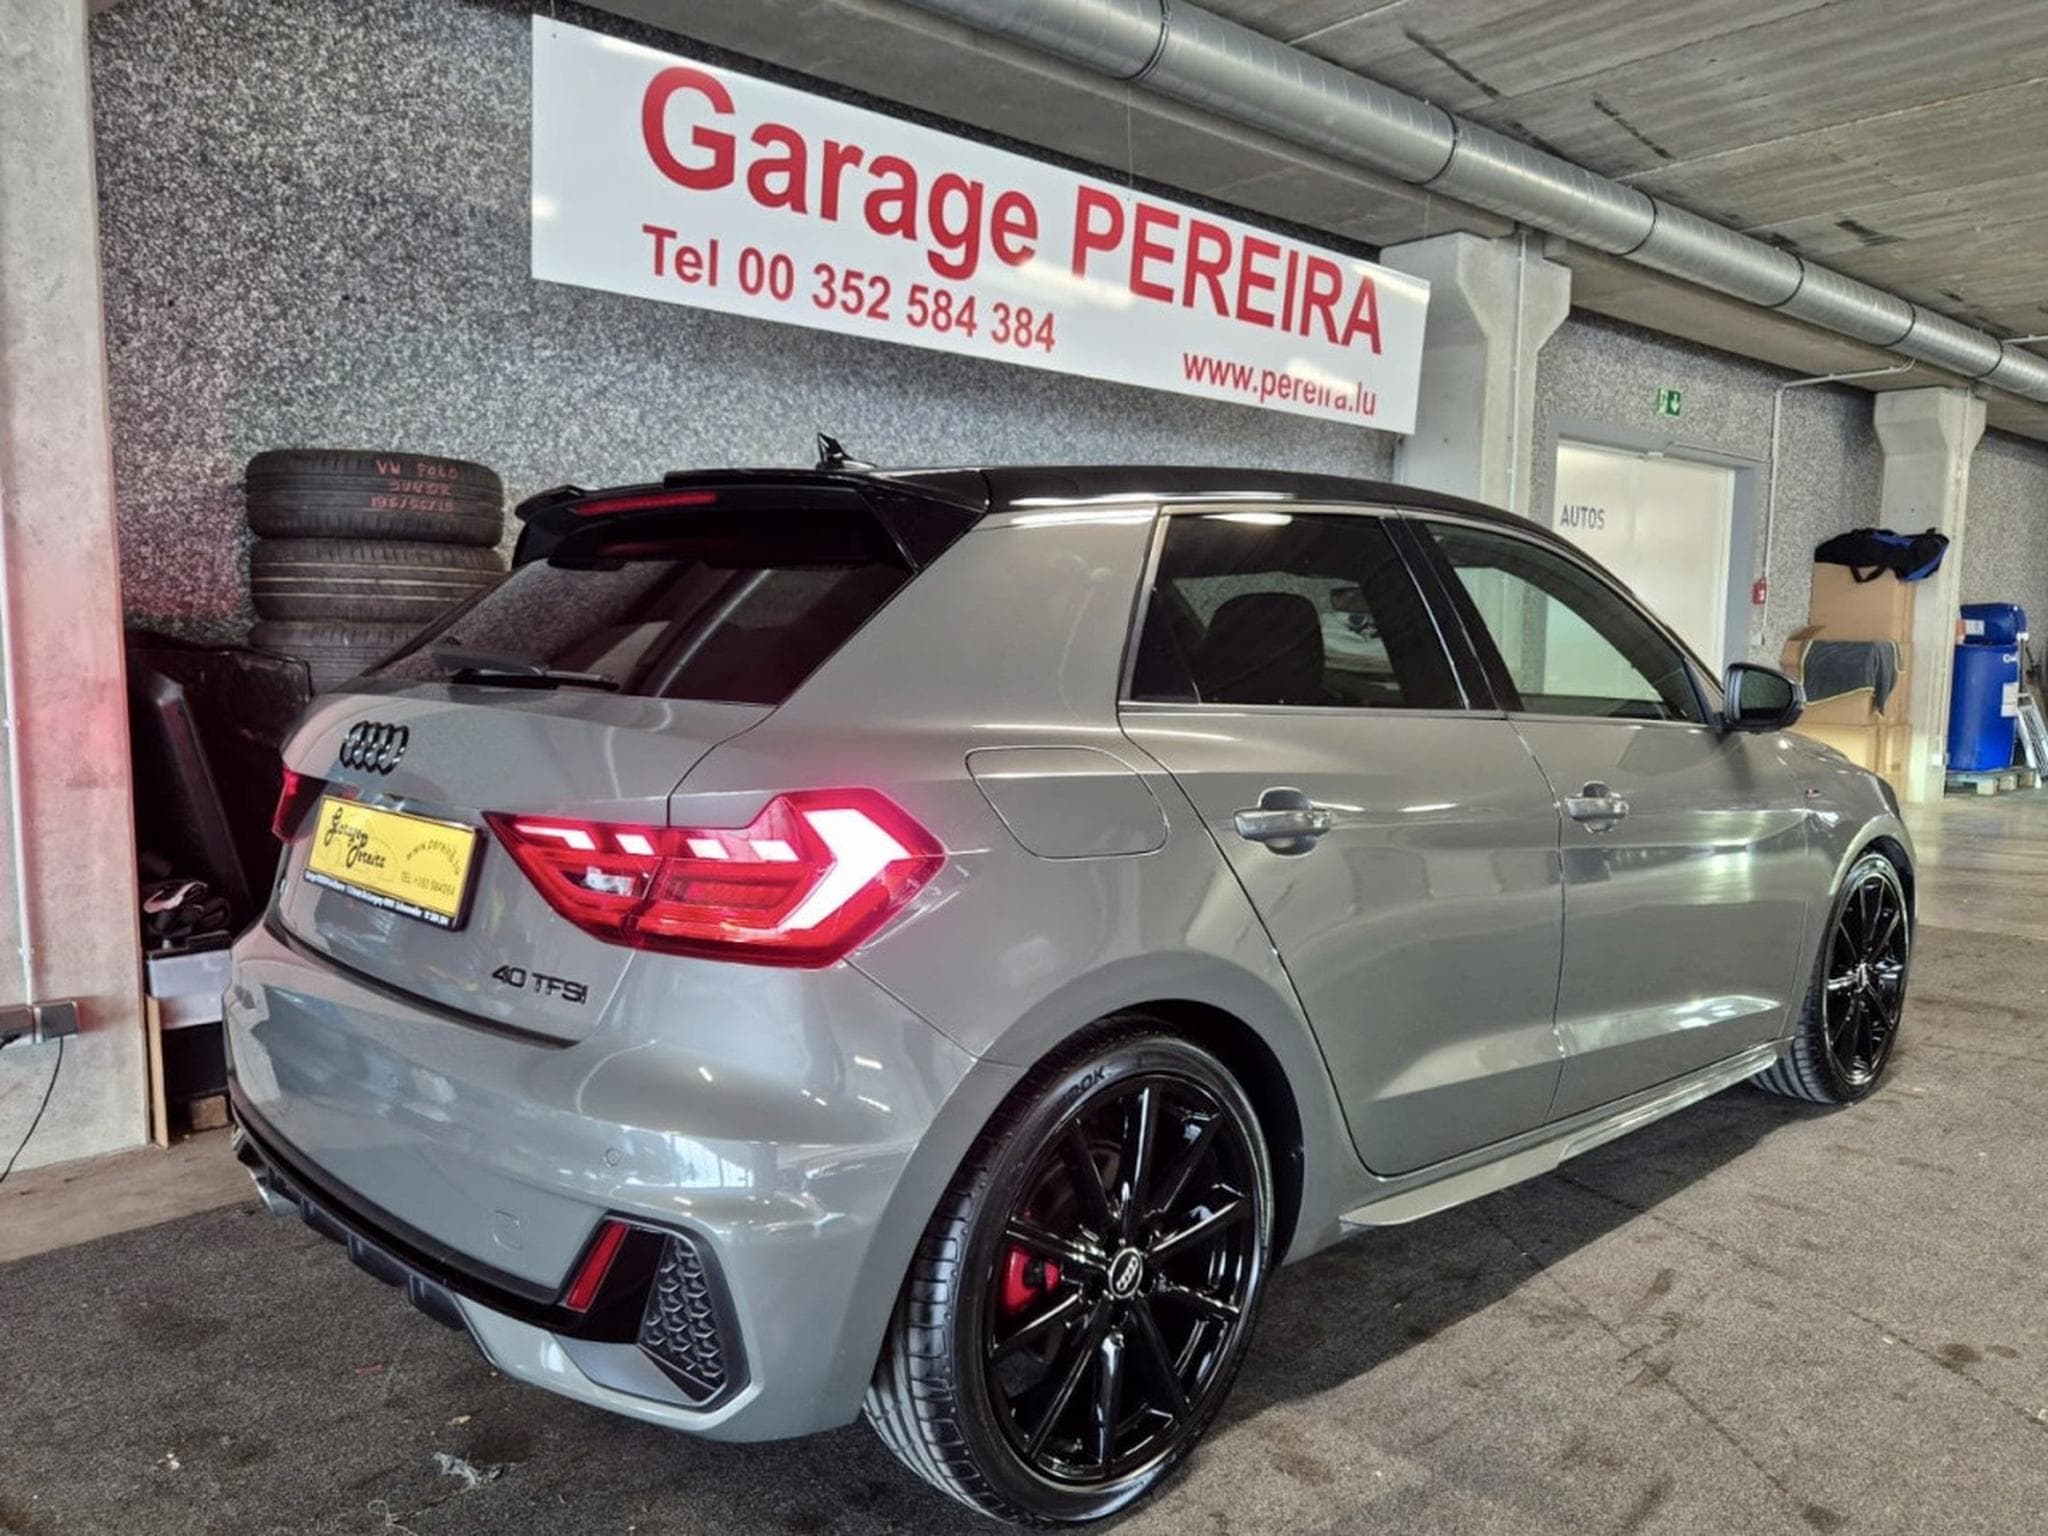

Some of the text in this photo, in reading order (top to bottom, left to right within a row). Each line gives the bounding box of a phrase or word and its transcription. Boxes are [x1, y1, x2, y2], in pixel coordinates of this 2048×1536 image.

[641, 66, 1383, 355] Garage PEREIRA
[642, 224, 1056, 353] Tel 00 352 584 384
[1183, 352, 1377, 418] www.pereira.lu
[417, 461, 459, 480] POLO
[1560, 504, 1606, 529] AUTOS
[492, 965, 589, 1005] 40 TFSI
